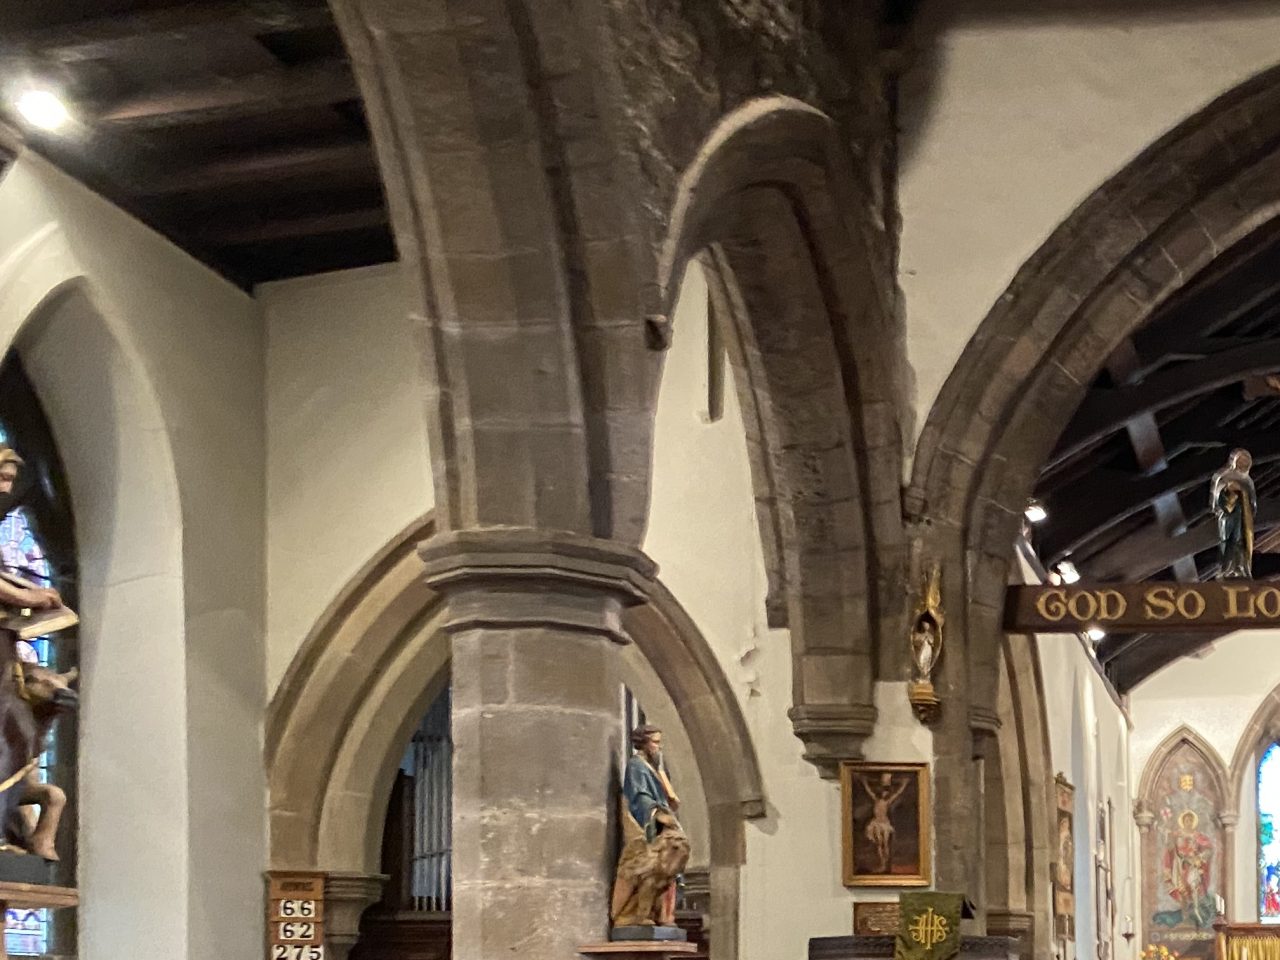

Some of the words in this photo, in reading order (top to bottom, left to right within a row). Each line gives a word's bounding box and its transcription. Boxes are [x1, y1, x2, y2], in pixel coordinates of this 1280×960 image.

[1036, 586, 1127, 621] GOD
[1145, 586, 1206, 620] SO
[283, 900, 312, 916] 66
[283, 922, 312, 939] 62
[275, 944, 322, 960] 275
